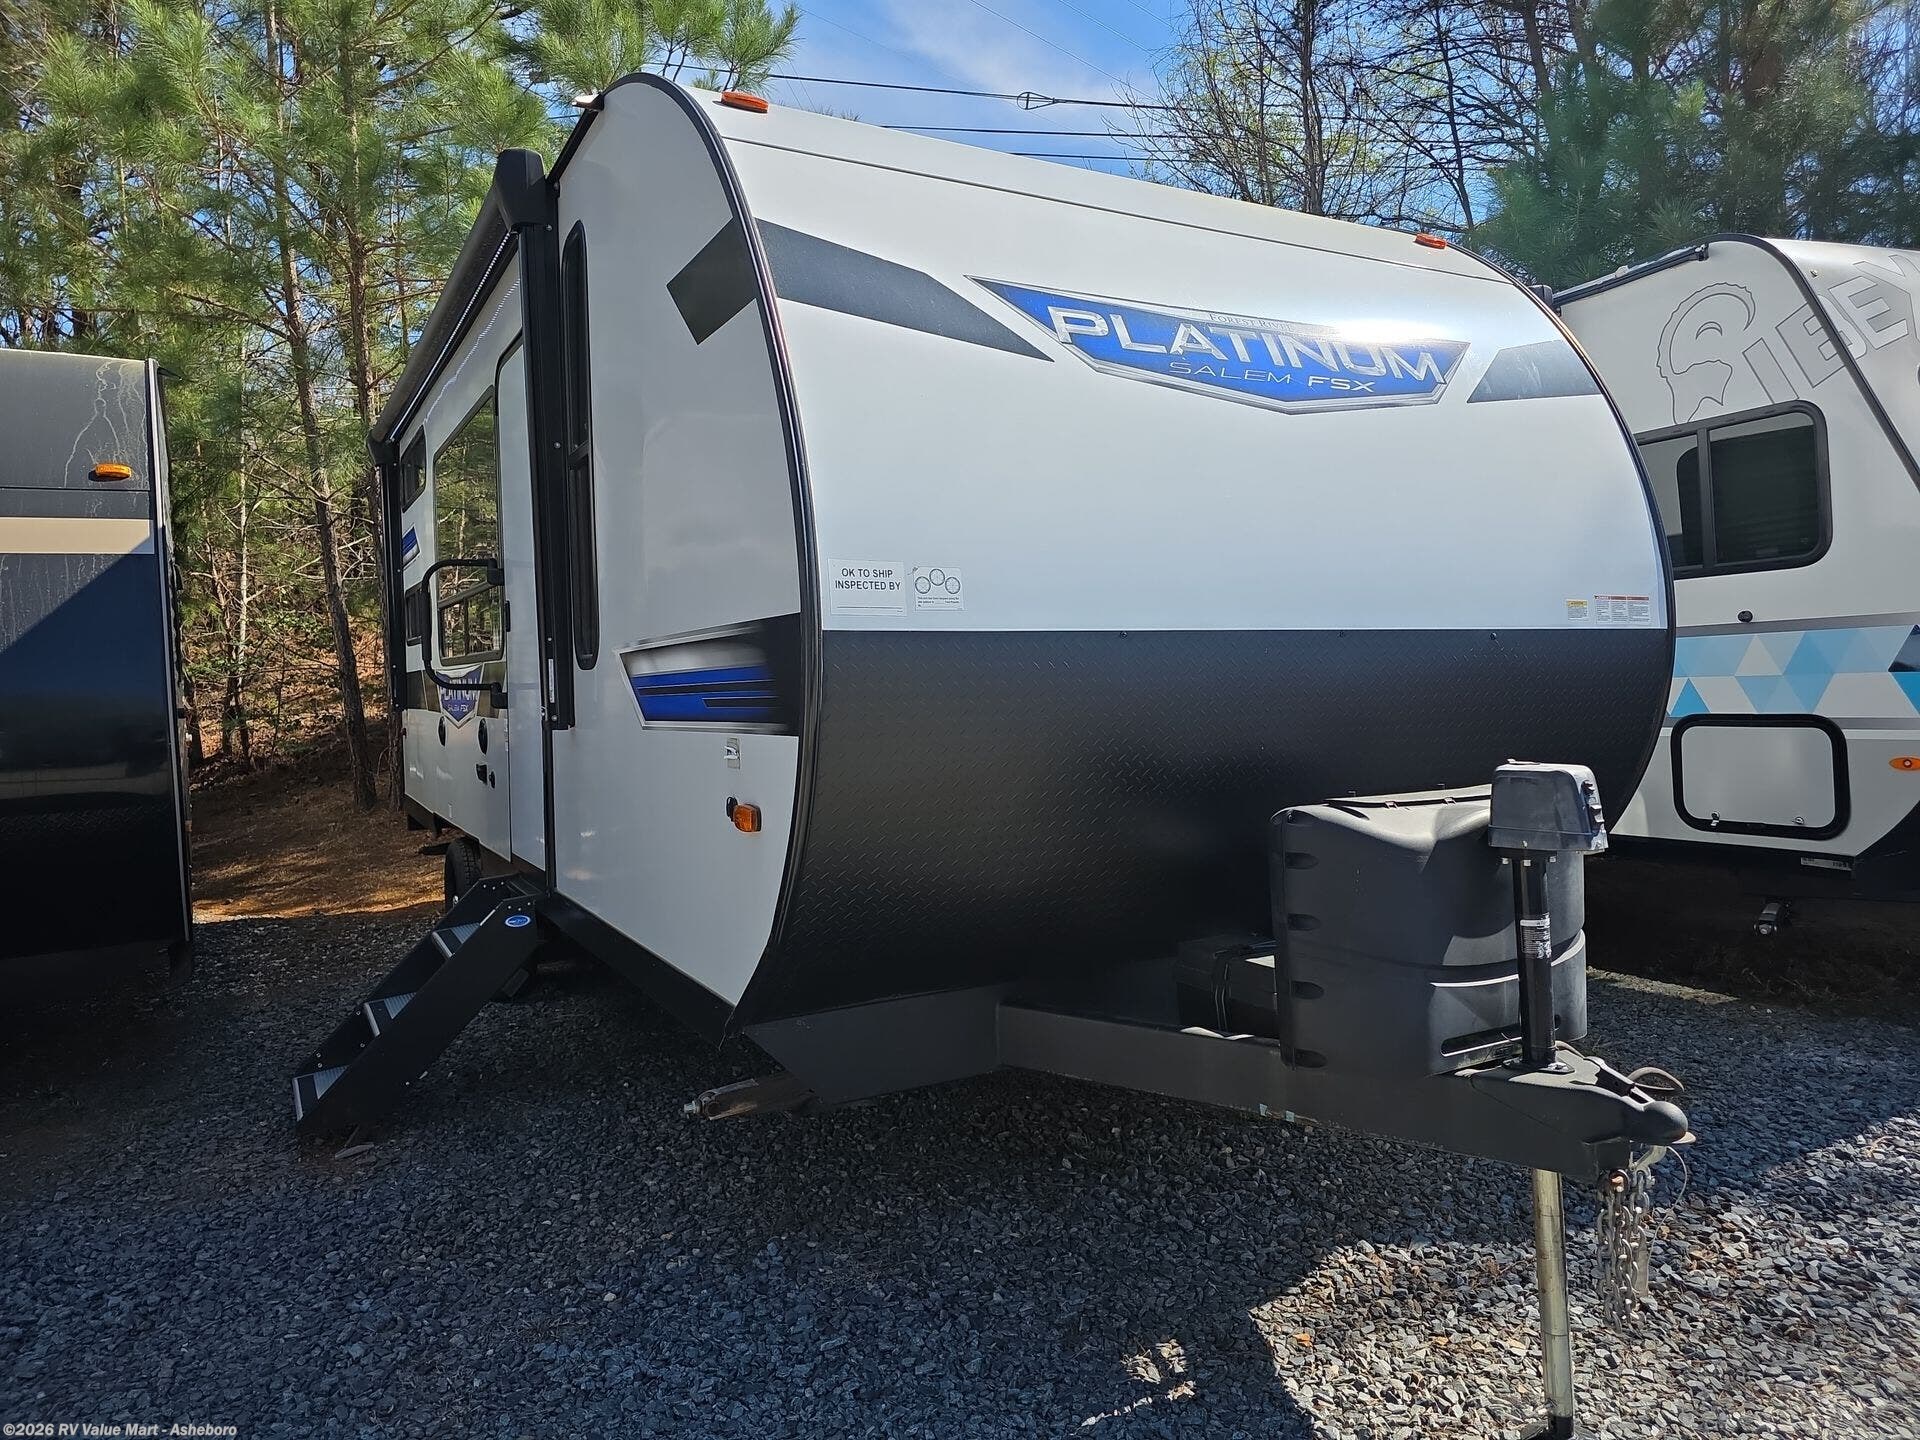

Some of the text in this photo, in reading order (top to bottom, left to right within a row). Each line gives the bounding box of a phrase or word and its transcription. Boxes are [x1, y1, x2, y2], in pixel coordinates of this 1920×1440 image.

[1046, 305, 1448, 384] PLATINUM
[1169, 360, 1376, 393] SALEM FSX
[841, 568, 893, 578] OK TO SHIP
[835, 580, 901, 591] INSPECTED BY
